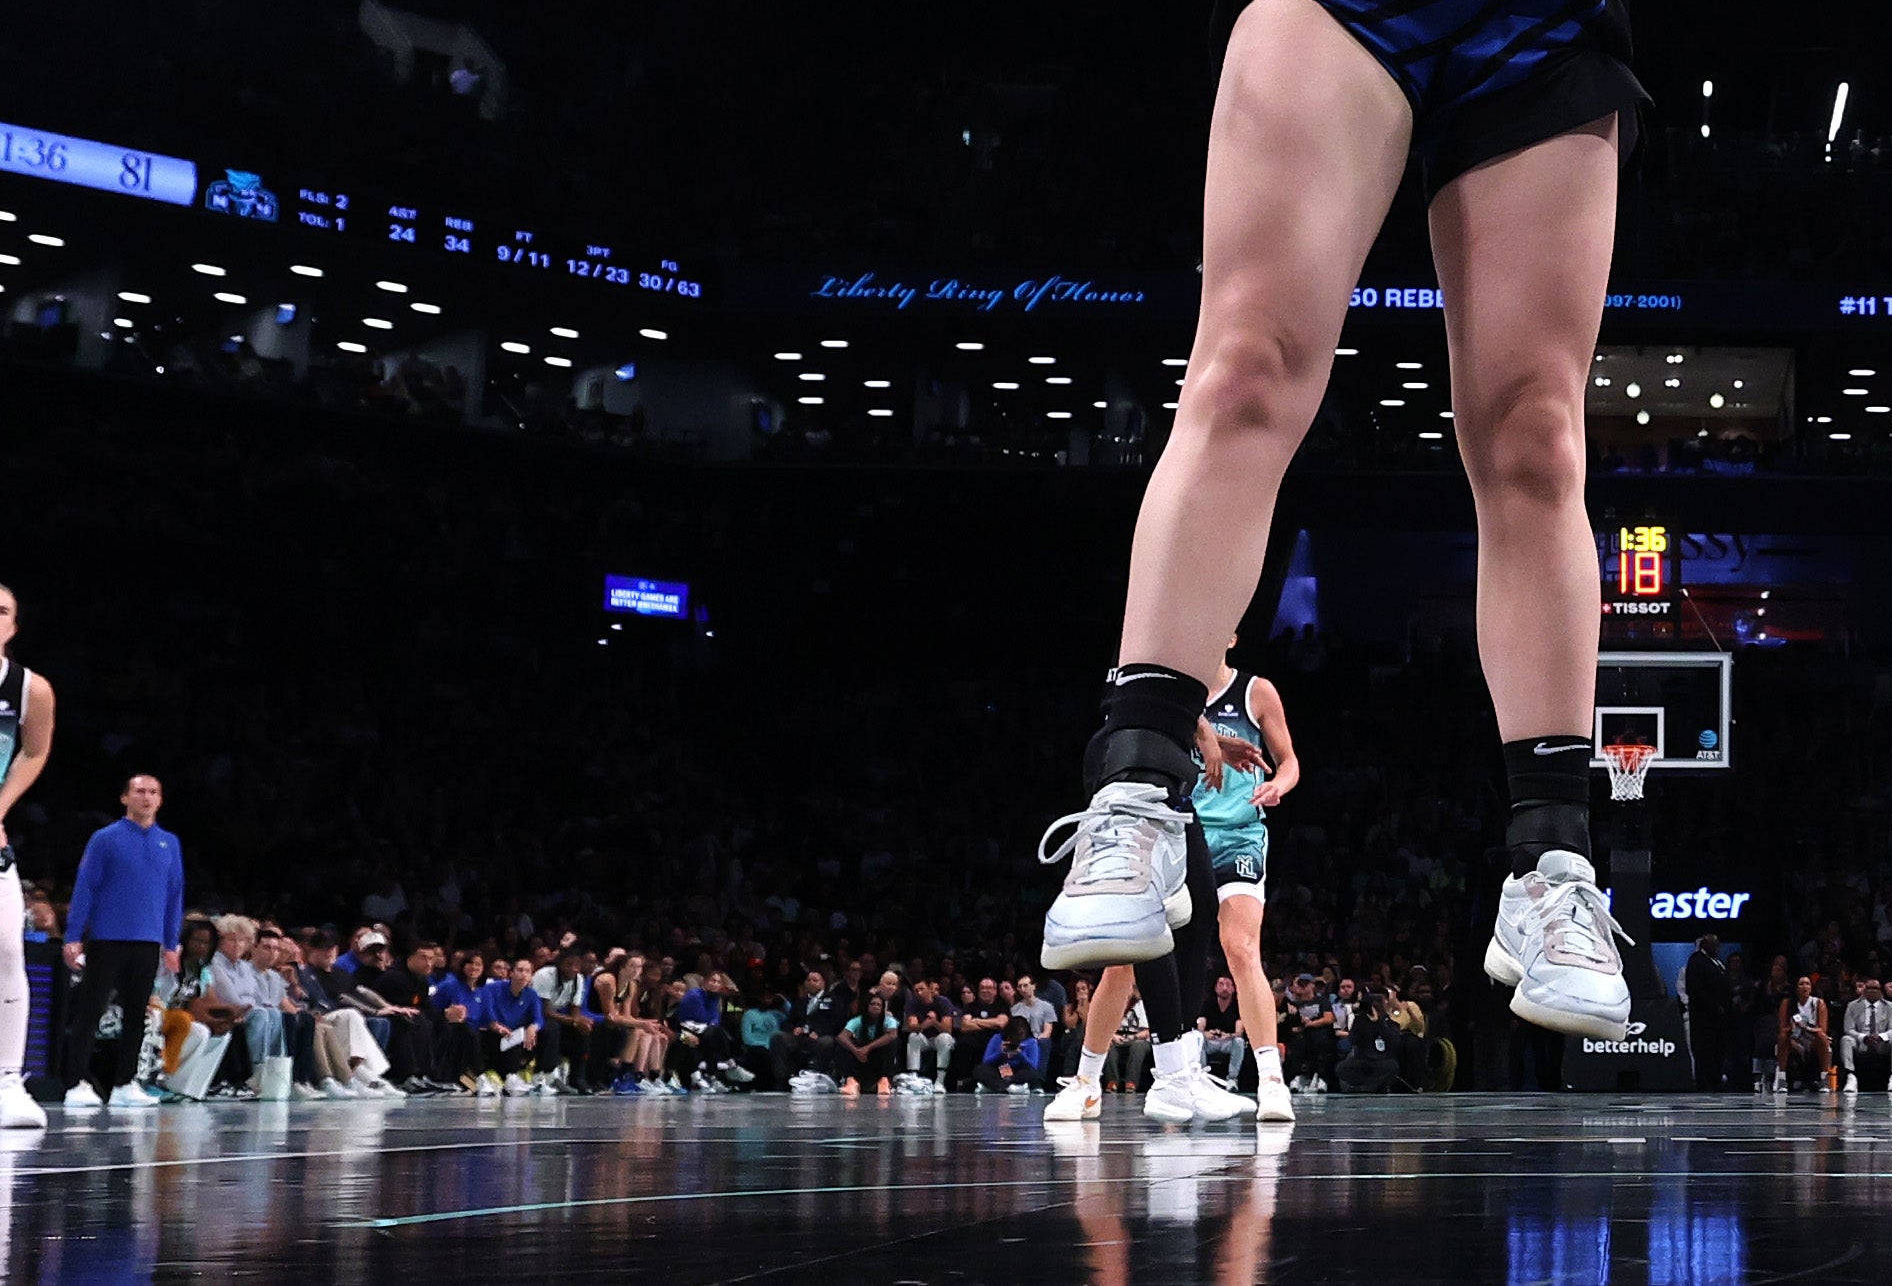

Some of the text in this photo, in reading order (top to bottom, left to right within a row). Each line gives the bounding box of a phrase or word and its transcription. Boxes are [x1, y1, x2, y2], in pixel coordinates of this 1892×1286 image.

[119, 152, 151, 192] 81
[335, 194, 349, 210] 2
[335, 217, 345, 232] 1
[388, 223, 416, 243] 24
[444, 234, 471, 254] 34
[515, 230, 534, 243] FT
[661, 259, 680, 273] FG
[810, 271, 1145, 312] Liberty Ring Of Honor
[1839, 296, 1876, 315] #11
[1620, 526, 1667, 552] 1:36
[1619, 551, 1663, 595] 18
[1612, 602, 1671, 614] TISSOT
[1696, 750, 1722, 760] AT&T
[1583, 1037, 1676, 1057] betterhelp
